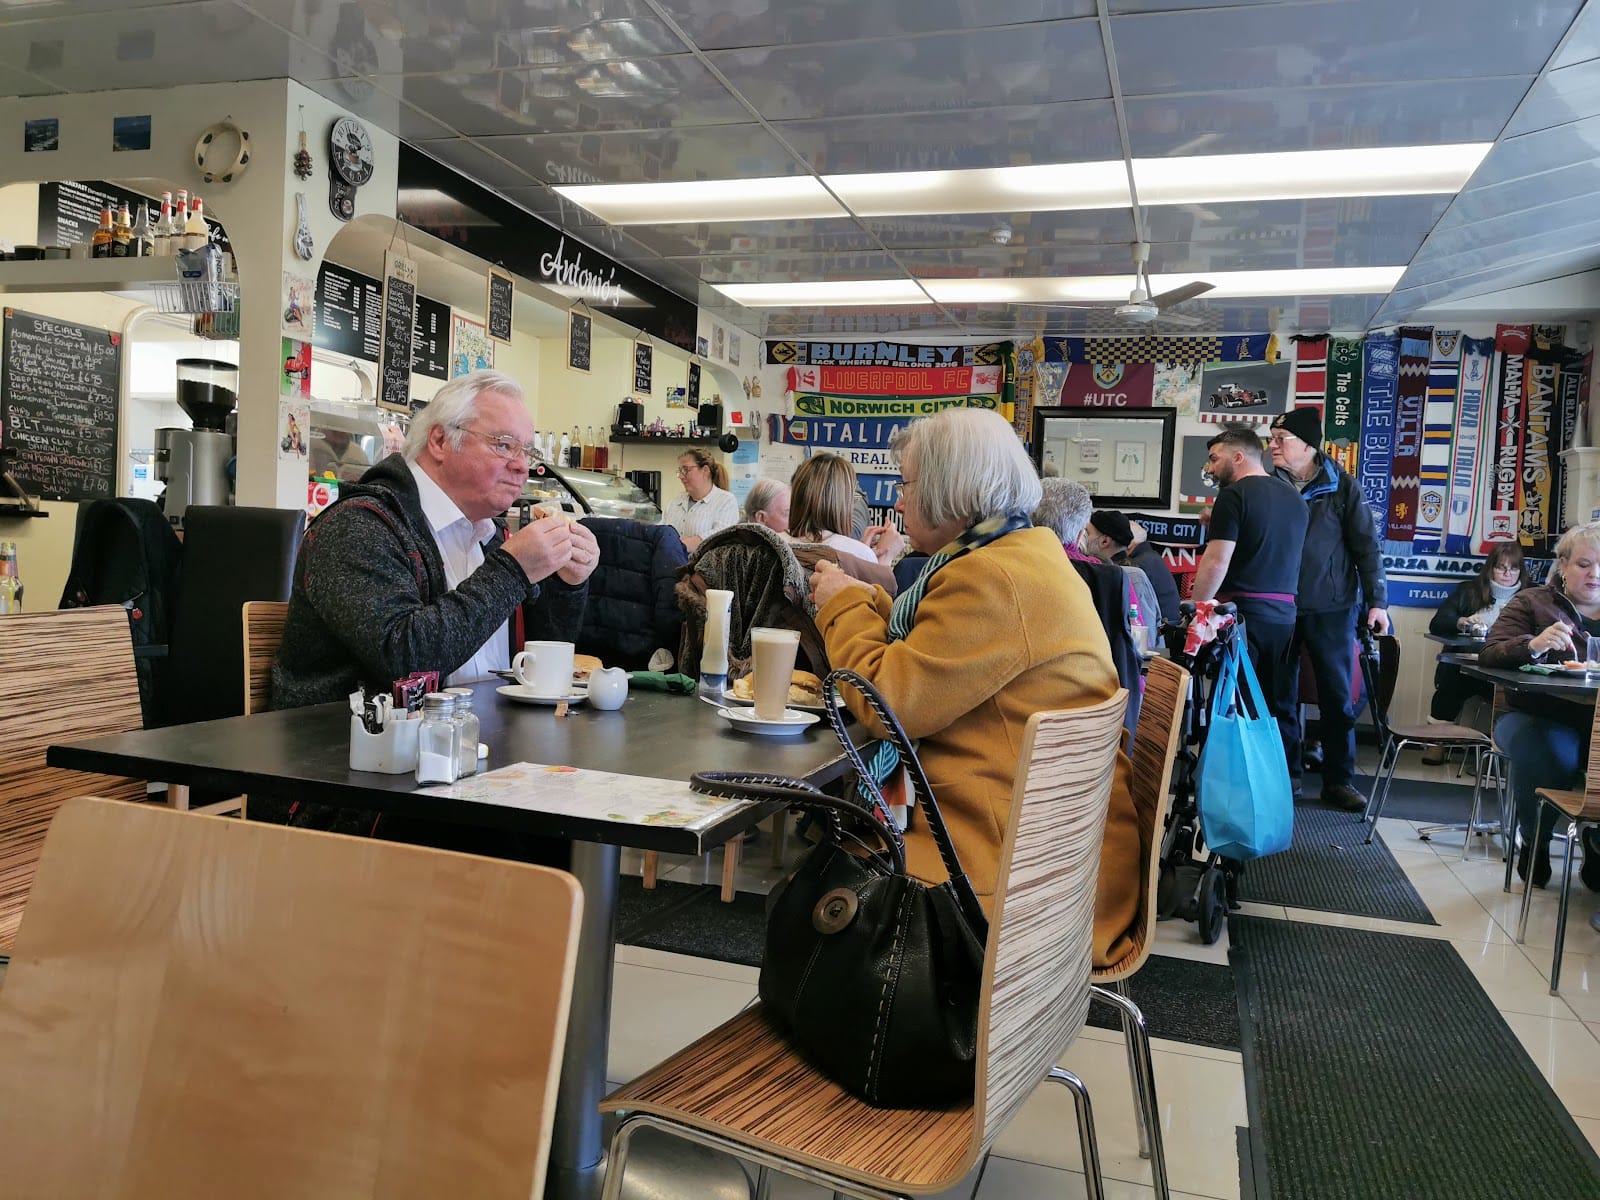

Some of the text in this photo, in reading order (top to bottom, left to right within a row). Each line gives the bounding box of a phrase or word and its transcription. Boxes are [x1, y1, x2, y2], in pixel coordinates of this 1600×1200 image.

[540, 236, 622, 306] Antonio's
[33, 320, 83, 338] SPECIALS
[811, 343, 959, 363] BURNLEY
[823, 370, 970, 391] LIVERPOOL FC
[1503, 354, 1524, 409] MALTA
[1567, 375, 1579, 394] ALL
[830, 400, 916, 414] NORWICH
[1083, 393, 1128, 407] #UTC
[1335, 372, 1352, 426] The Celts
[1399, 395, 1420, 457] VILLA
[1523, 364, 1556, 483] BANTAMS
[9, 430, 50, 445] CHICKEN
[1361, 381, 1394, 503] THE BLUES
[851, 453, 889, 465] REAL
[1497, 445, 1518, 503] RUGBY
[1173, 524, 1197, 537] CITY
[1383, 556, 1429, 570] ORZA
[1408, 589, 1450, 603] ITALIA
